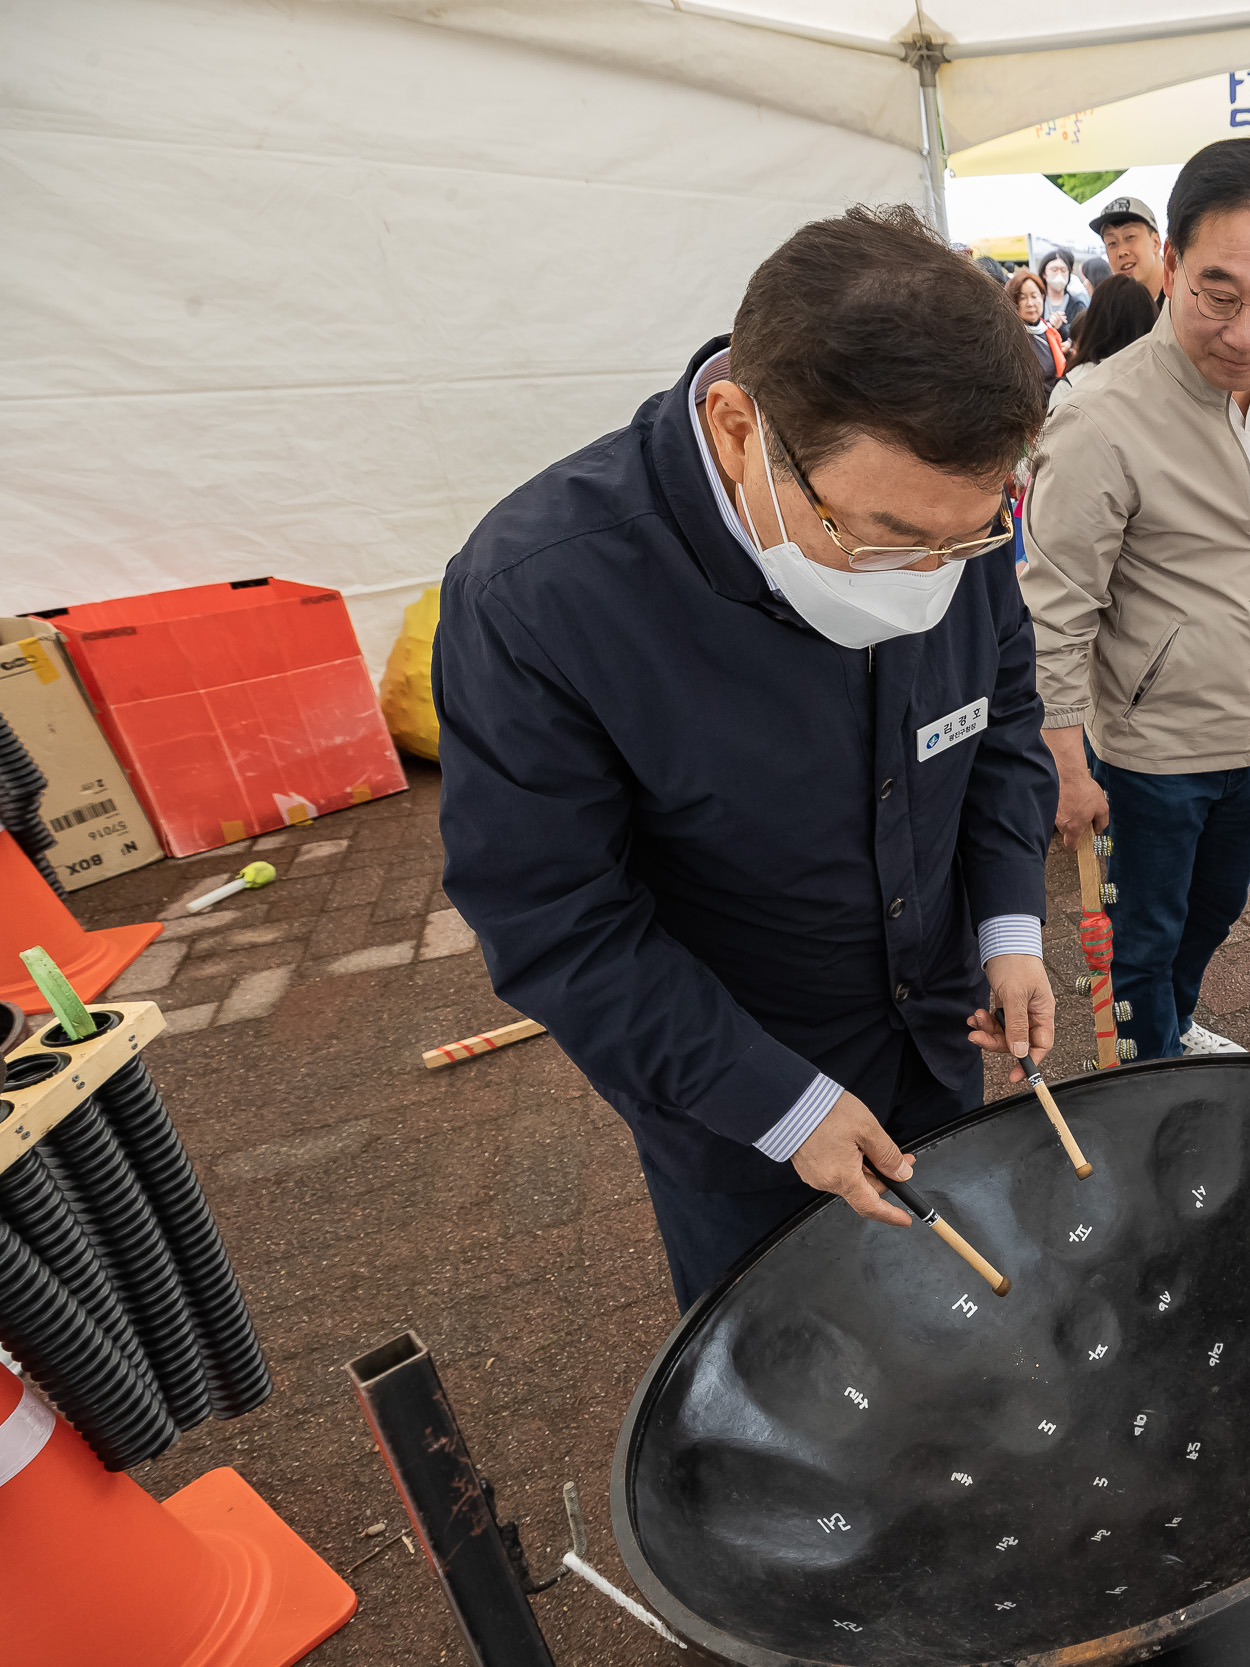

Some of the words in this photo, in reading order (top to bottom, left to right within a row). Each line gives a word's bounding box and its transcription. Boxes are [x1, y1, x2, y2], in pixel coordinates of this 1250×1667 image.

[949, 722, 977, 742] 광진구청장
[65, 854, 103, 876] BOX
[1069, 1224, 1092, 1242] 파
[952, 1294, 978, 1318] 도
[1089, 1344, 1108, 1360] 파
[844, 1387, 868, 1409] 솔
[1038, 1420, 1056, 1435] 도
[951, 1473, 973, 1486] 솔
[817, 1513, 851, 1533] 레
[833, 1620, 863, 1632] 라
